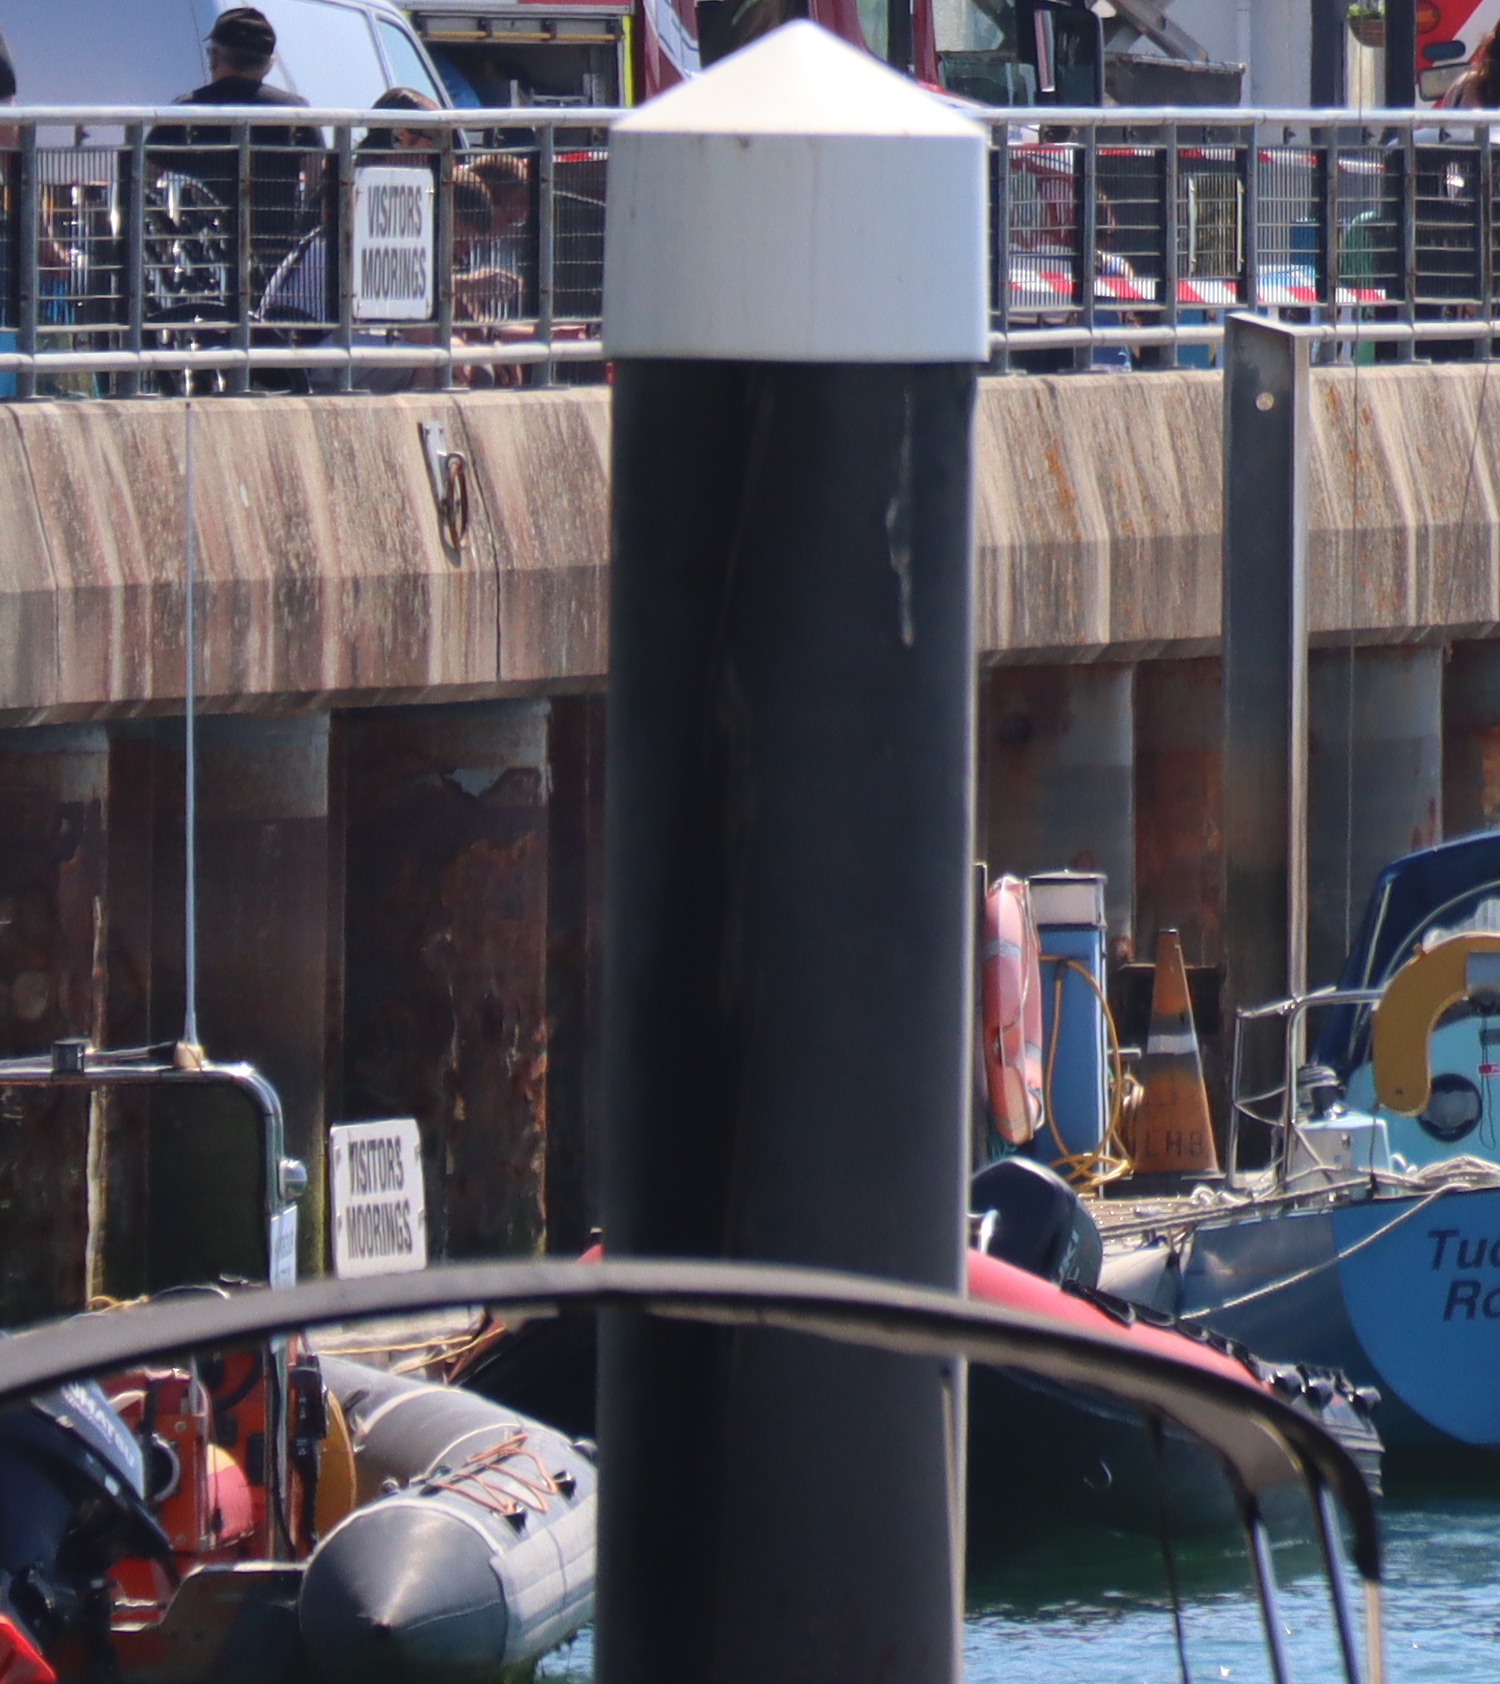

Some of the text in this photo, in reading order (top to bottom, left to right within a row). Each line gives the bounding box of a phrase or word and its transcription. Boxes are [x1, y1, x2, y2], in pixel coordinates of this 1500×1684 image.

[368, 184, 422, 239] VISITORS
[361, 246, 426, 301] MOORINGS
[347, 1135, 404, 1196] VISITORS
[346, 1198, 413, 1260] MOORINGS
